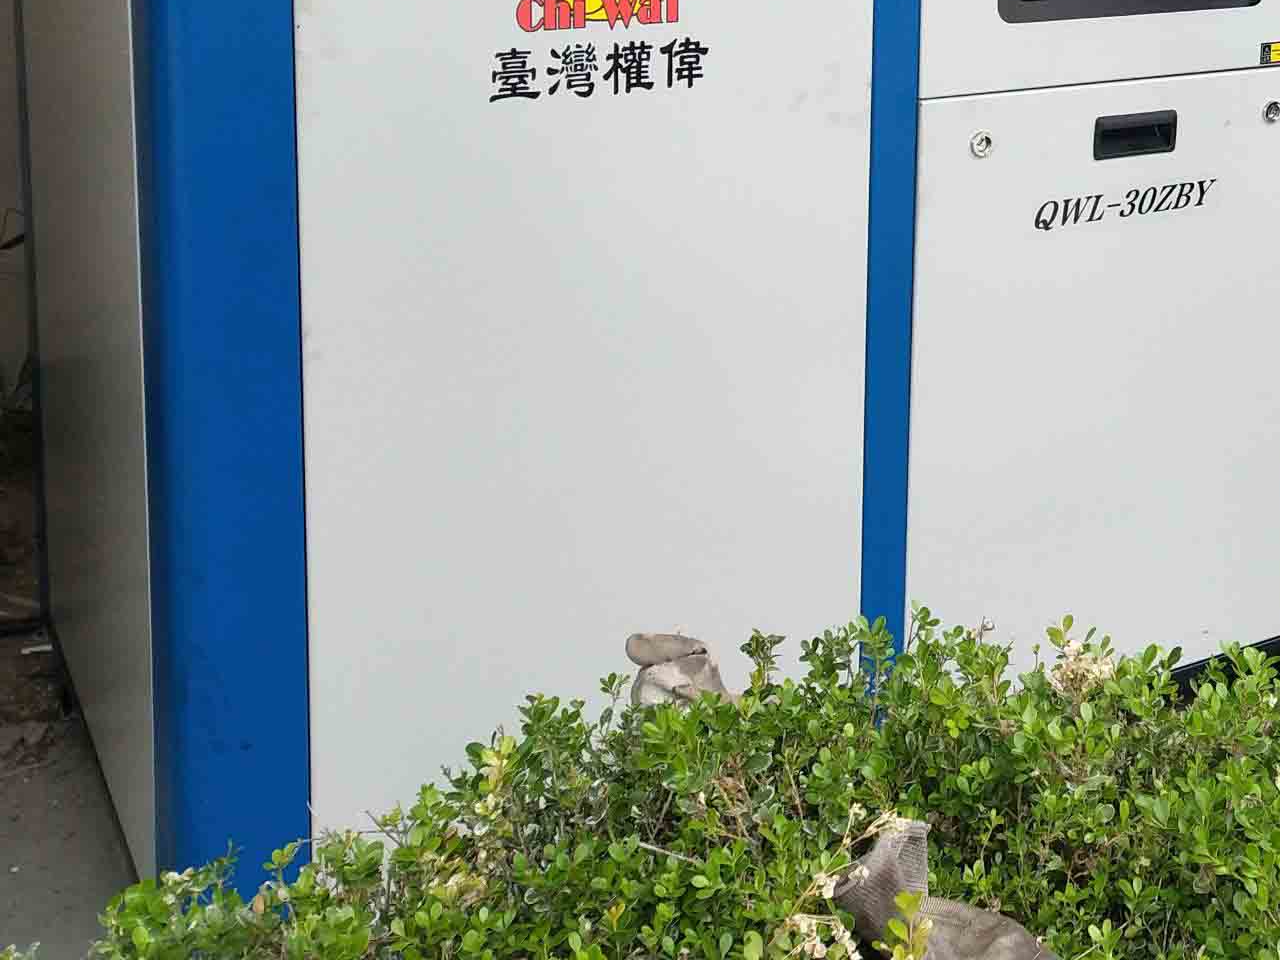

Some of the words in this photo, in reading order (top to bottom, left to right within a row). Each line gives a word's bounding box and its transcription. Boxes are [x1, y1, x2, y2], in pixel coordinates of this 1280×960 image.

[489, 37, 709, 103] 臺灣權偉
[1034, 178, 1217, 231] QWL-30ZBY
